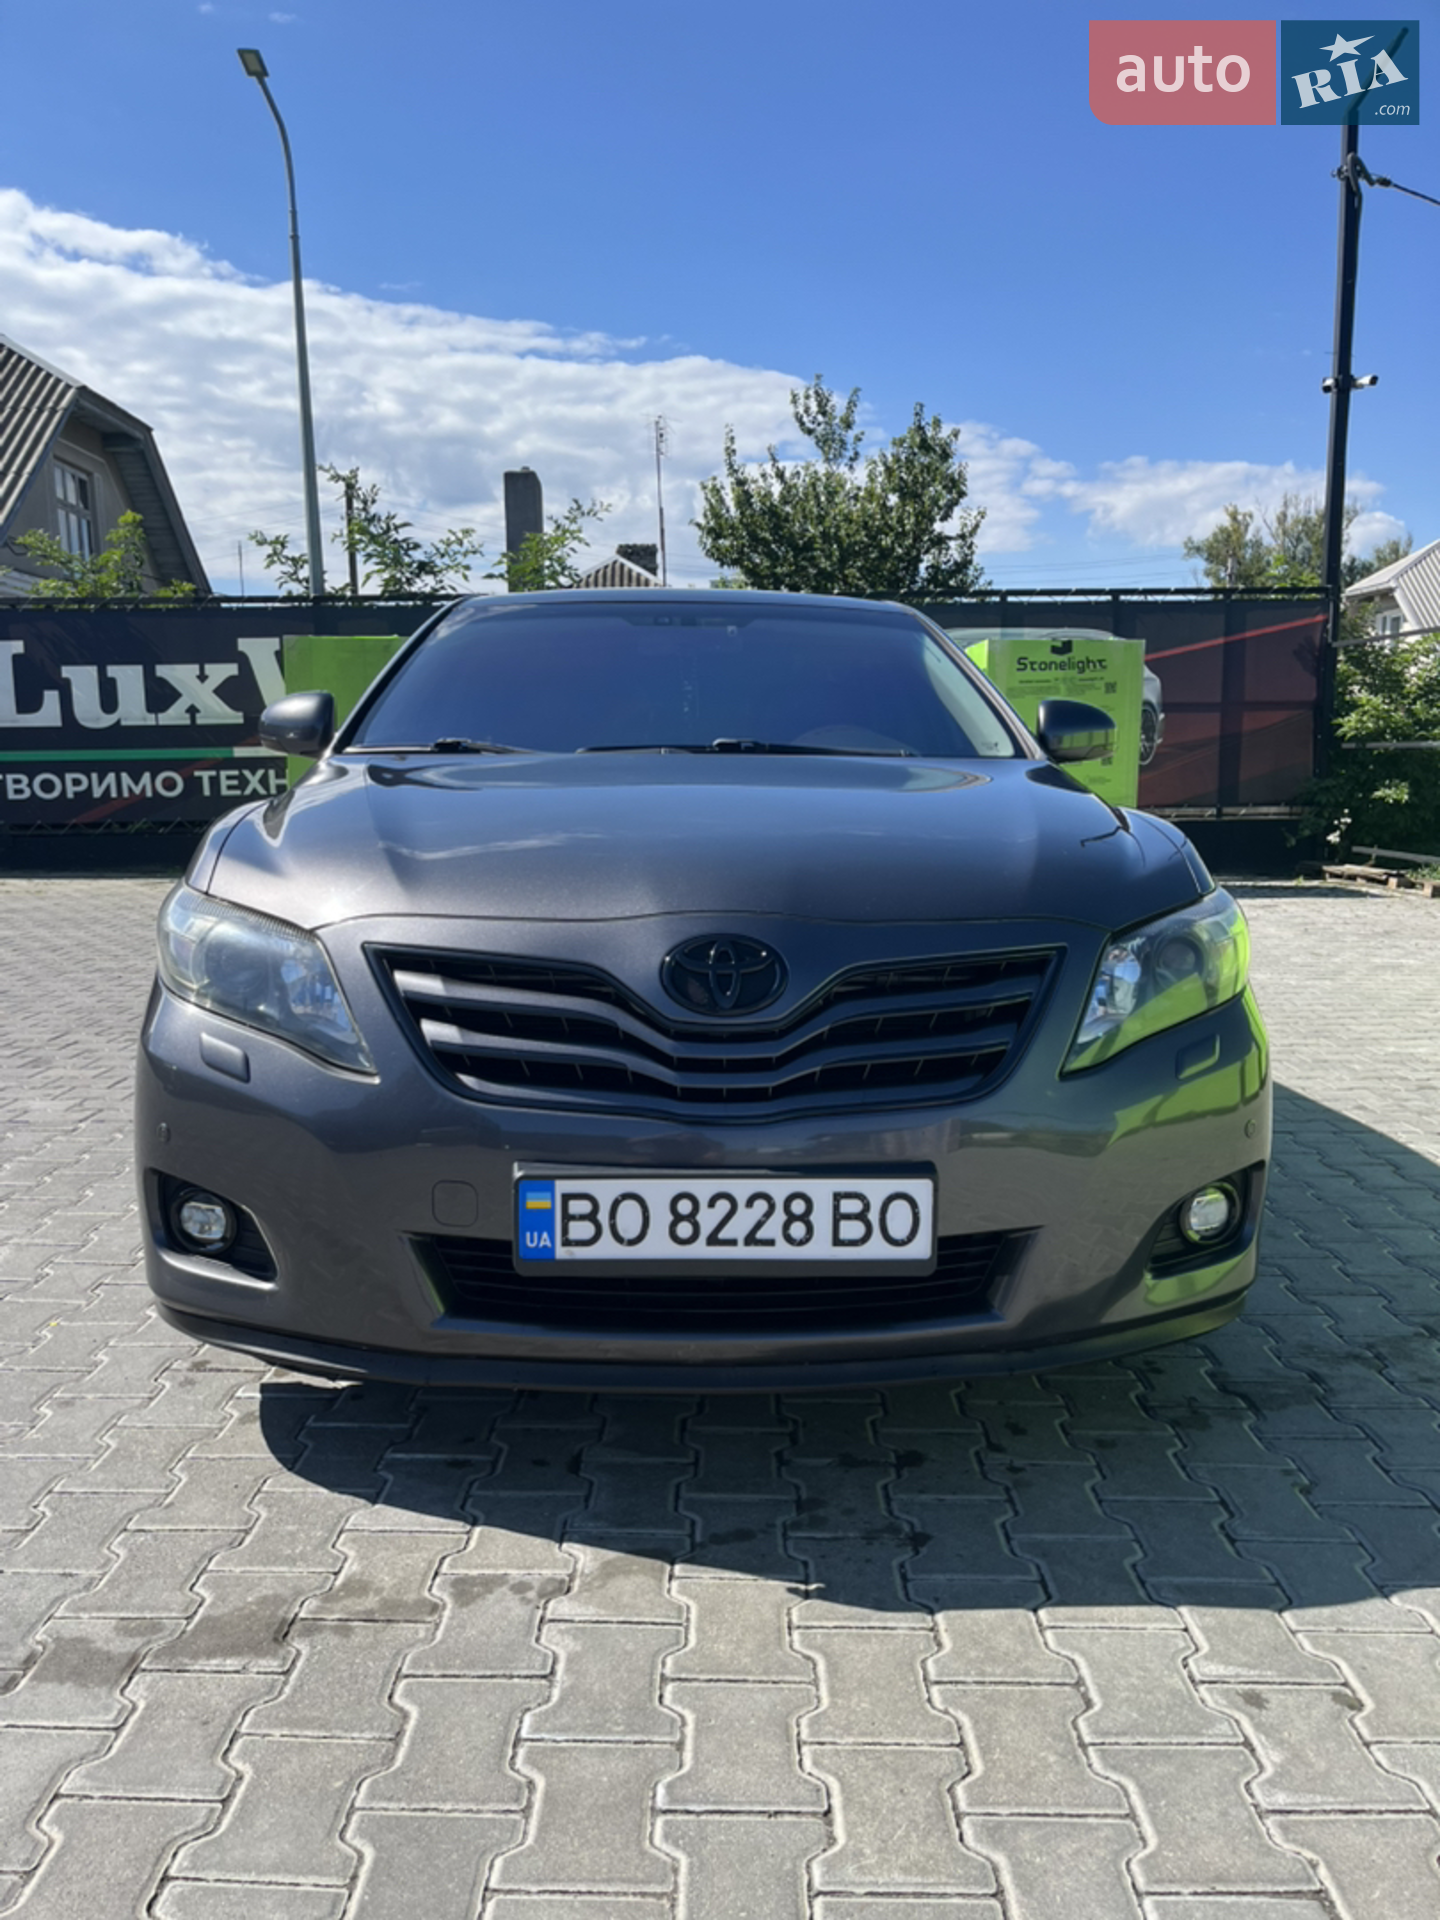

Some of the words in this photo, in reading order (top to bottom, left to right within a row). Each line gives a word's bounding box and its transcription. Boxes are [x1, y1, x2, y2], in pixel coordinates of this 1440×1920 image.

[1016, 656, 1108, 674] Stonelight
[0, 768, 184, 801] ВОРИМО
[560, 1191, 651, 1247] BO
[668, 1190, 815, 1248] 8228
[831, 1190, 921, 1248] BO
[526, 1231, 552, 1249] UA
